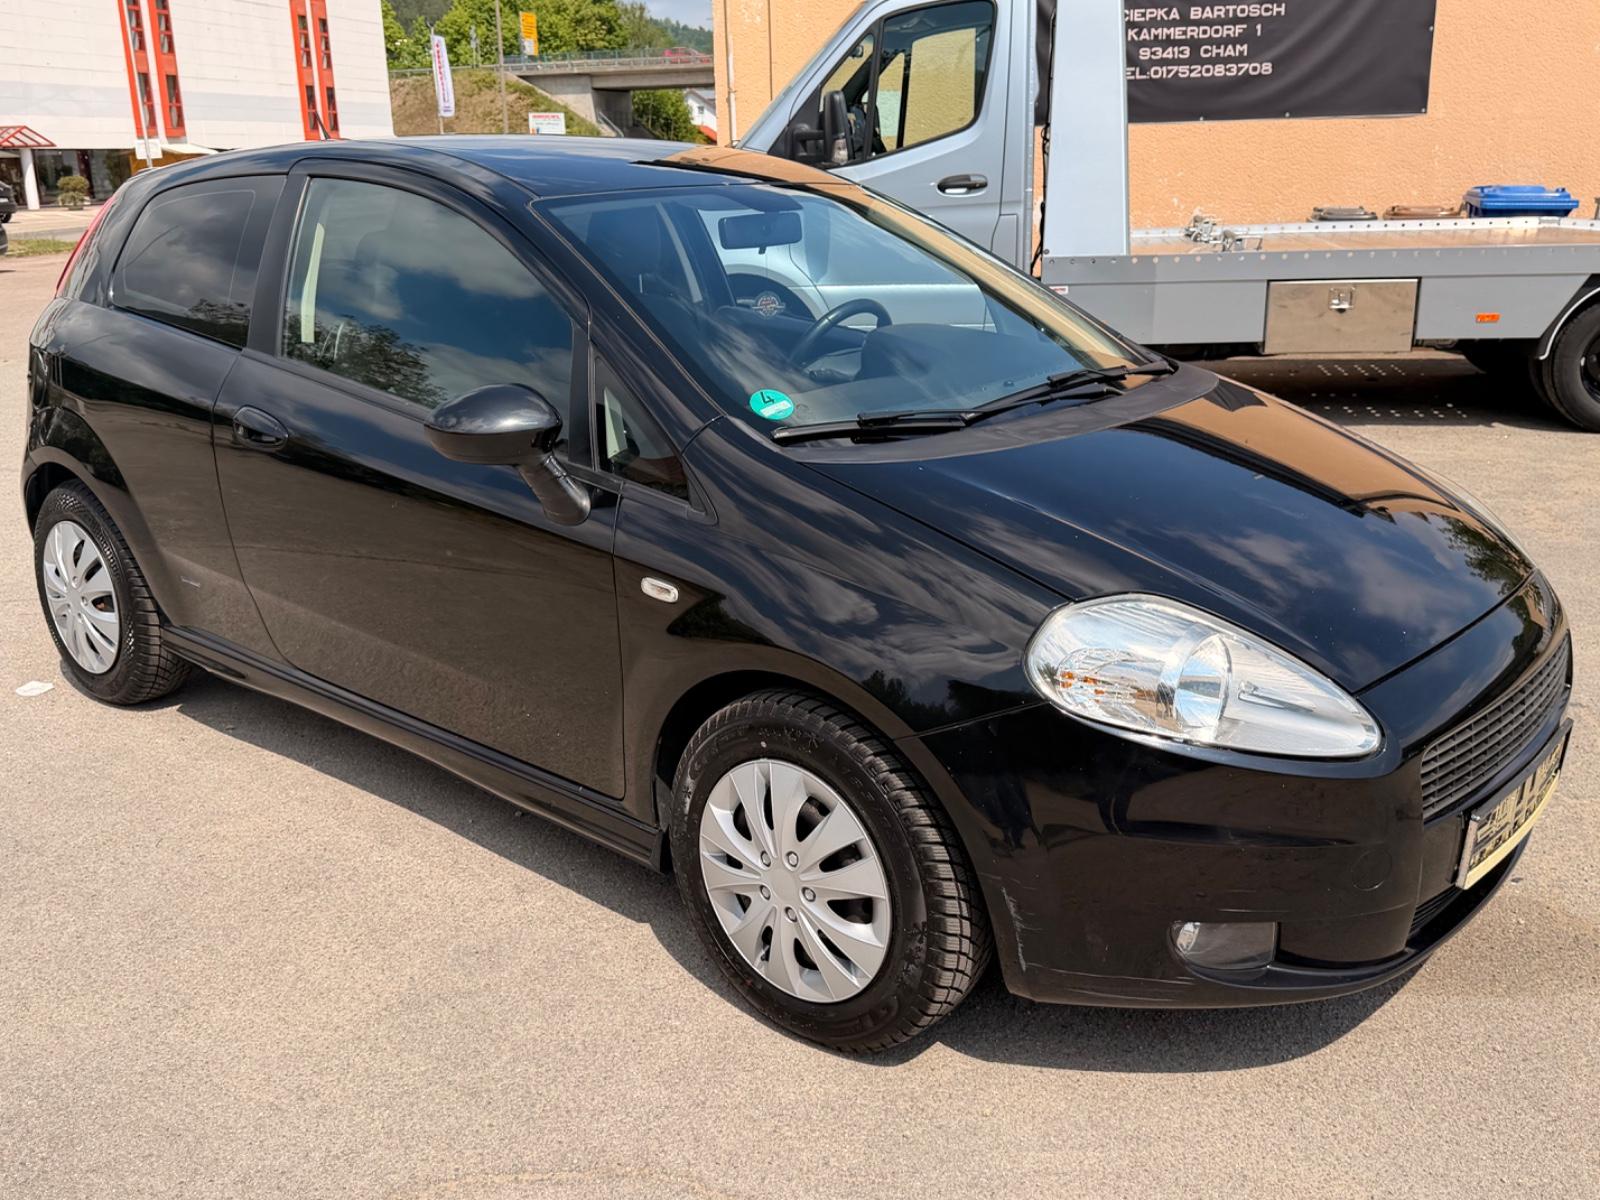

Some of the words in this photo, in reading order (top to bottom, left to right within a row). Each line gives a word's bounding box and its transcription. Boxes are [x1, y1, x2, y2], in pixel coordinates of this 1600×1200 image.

[1190, 3, 1286, 19] BARTOSCH
[1127, 25, 1247, 41] KAMMERDORF
[1255, 23, 1262, 37] 1
[1138, 46, 1191, 60] 93413
[1200, 43, 1248, 58] CHAM
[1125, 62, 1273, 80] EL:01752083708
[760, 391, 775, 404] 4
